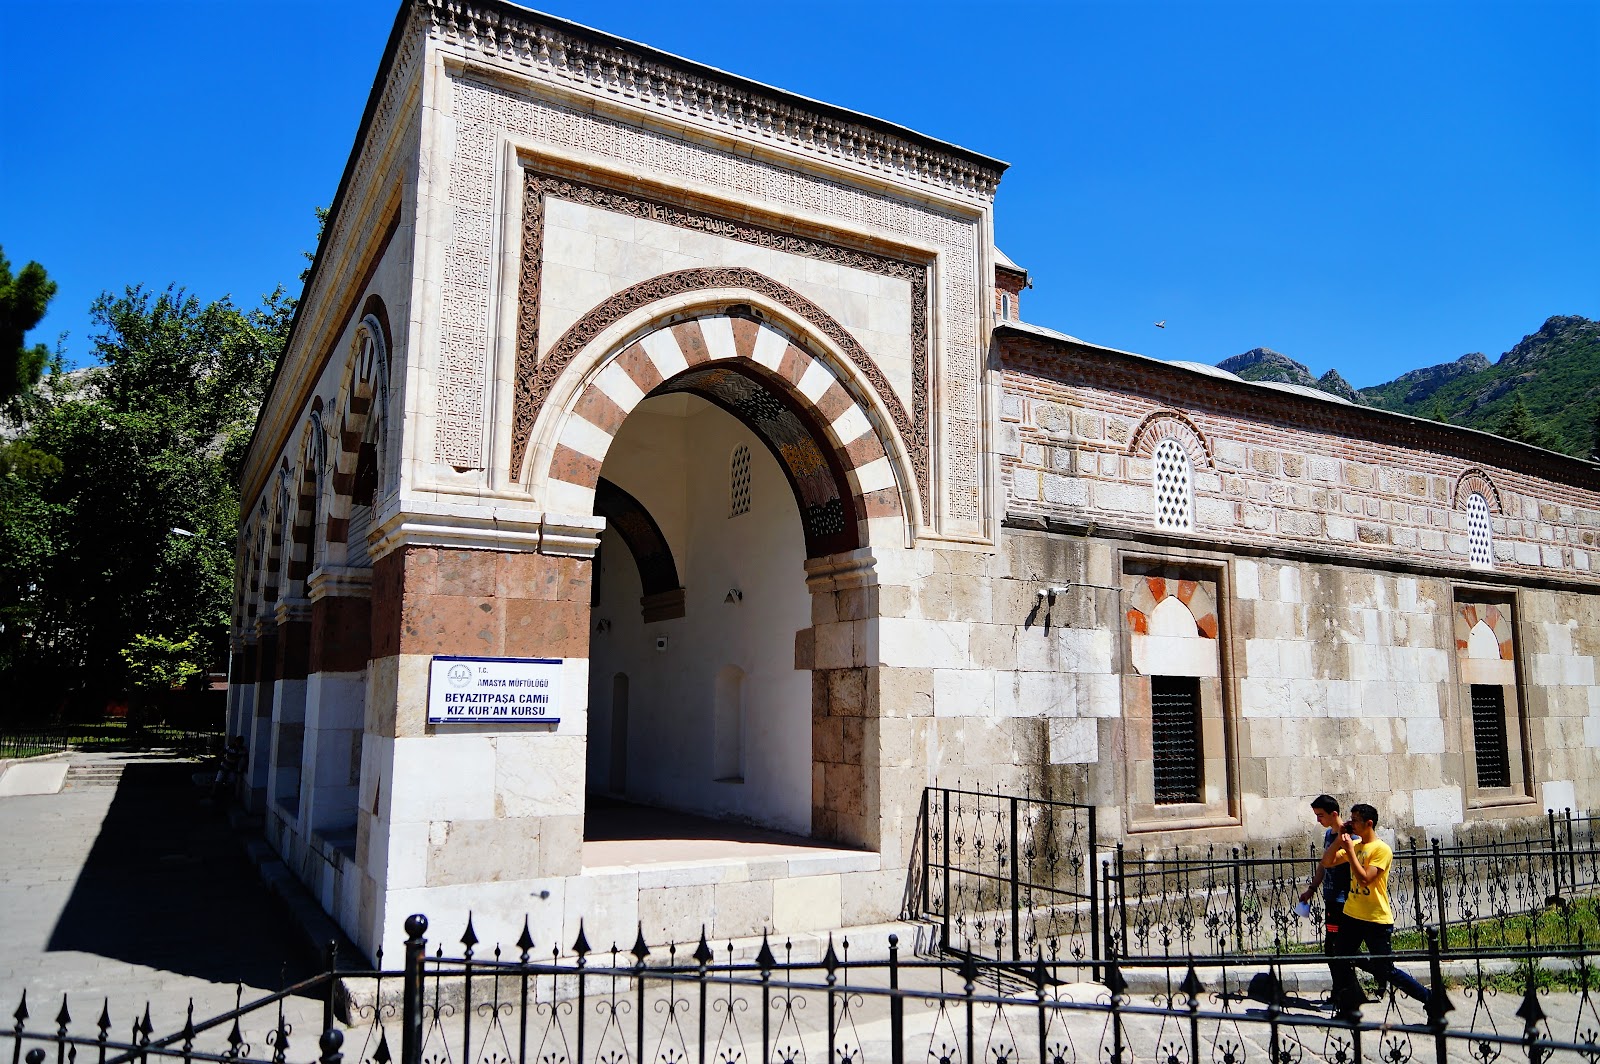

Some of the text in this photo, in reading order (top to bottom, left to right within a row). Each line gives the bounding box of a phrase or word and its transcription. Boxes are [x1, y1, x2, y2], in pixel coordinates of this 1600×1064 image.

[477, 678, 549, 688] AMASYA MÜFTÜLÜĞÜ
[445, 693, 516, 704] BEYAZITPAŞA
[447, 706, 546, 716] KIZ KUR'AN KURSU
